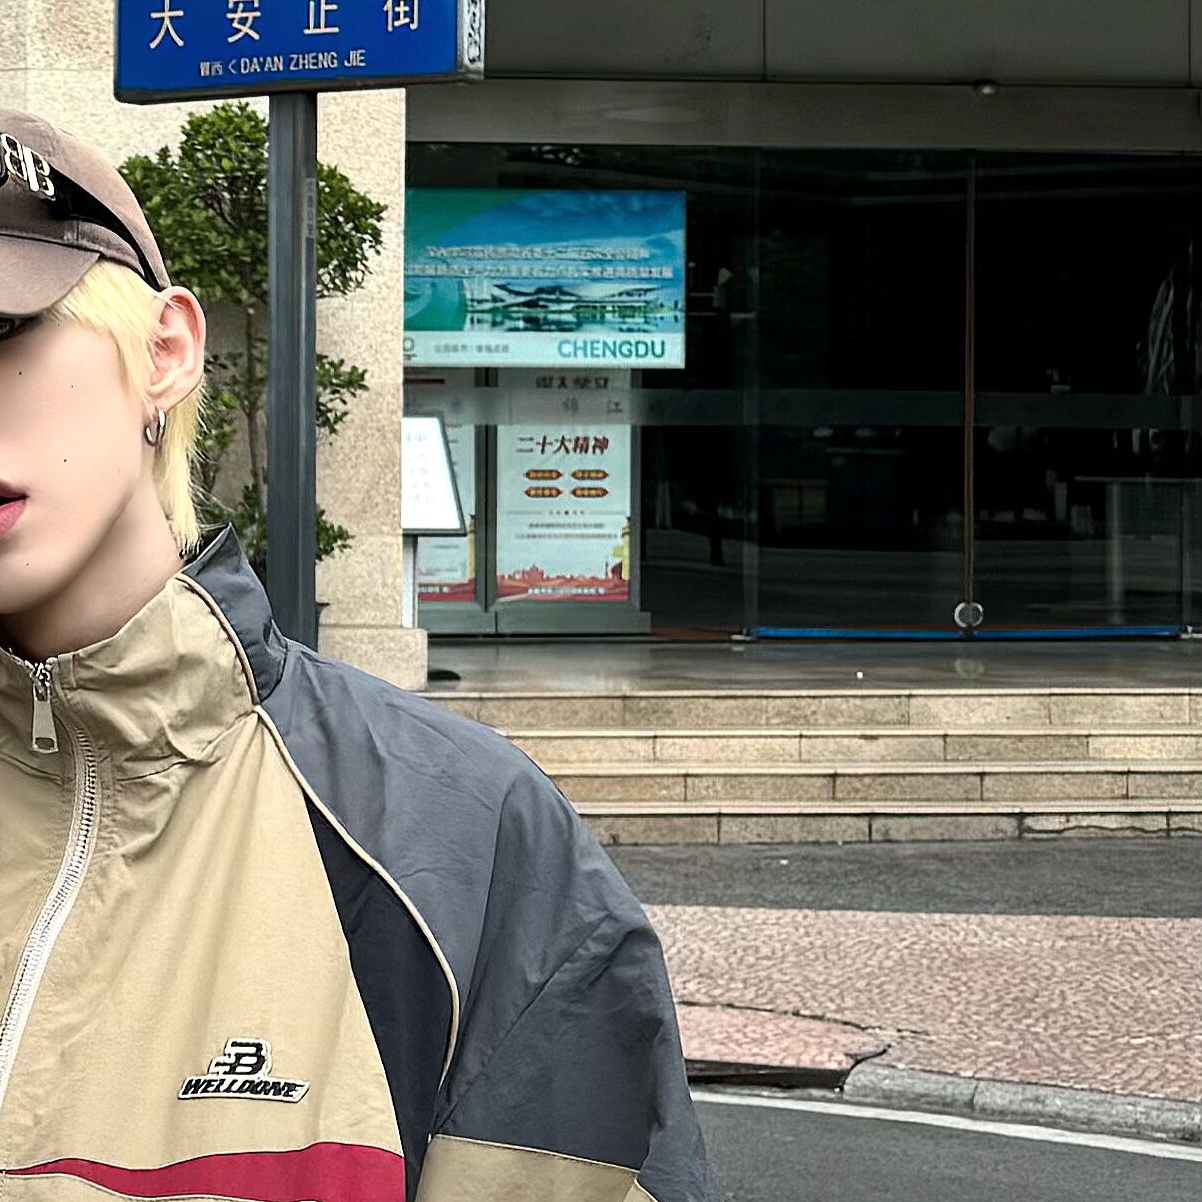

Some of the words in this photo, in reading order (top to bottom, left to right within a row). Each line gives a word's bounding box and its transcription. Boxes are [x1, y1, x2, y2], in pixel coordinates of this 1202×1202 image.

[240, 55, 284, 75] DA'AN
[289, 51, 338, 71] ZHENG
[344, 49, 367, 67] JIE
[557, 339, 666, 358] CHENGDU
[516, 435, 610, 455] 二十大精神
